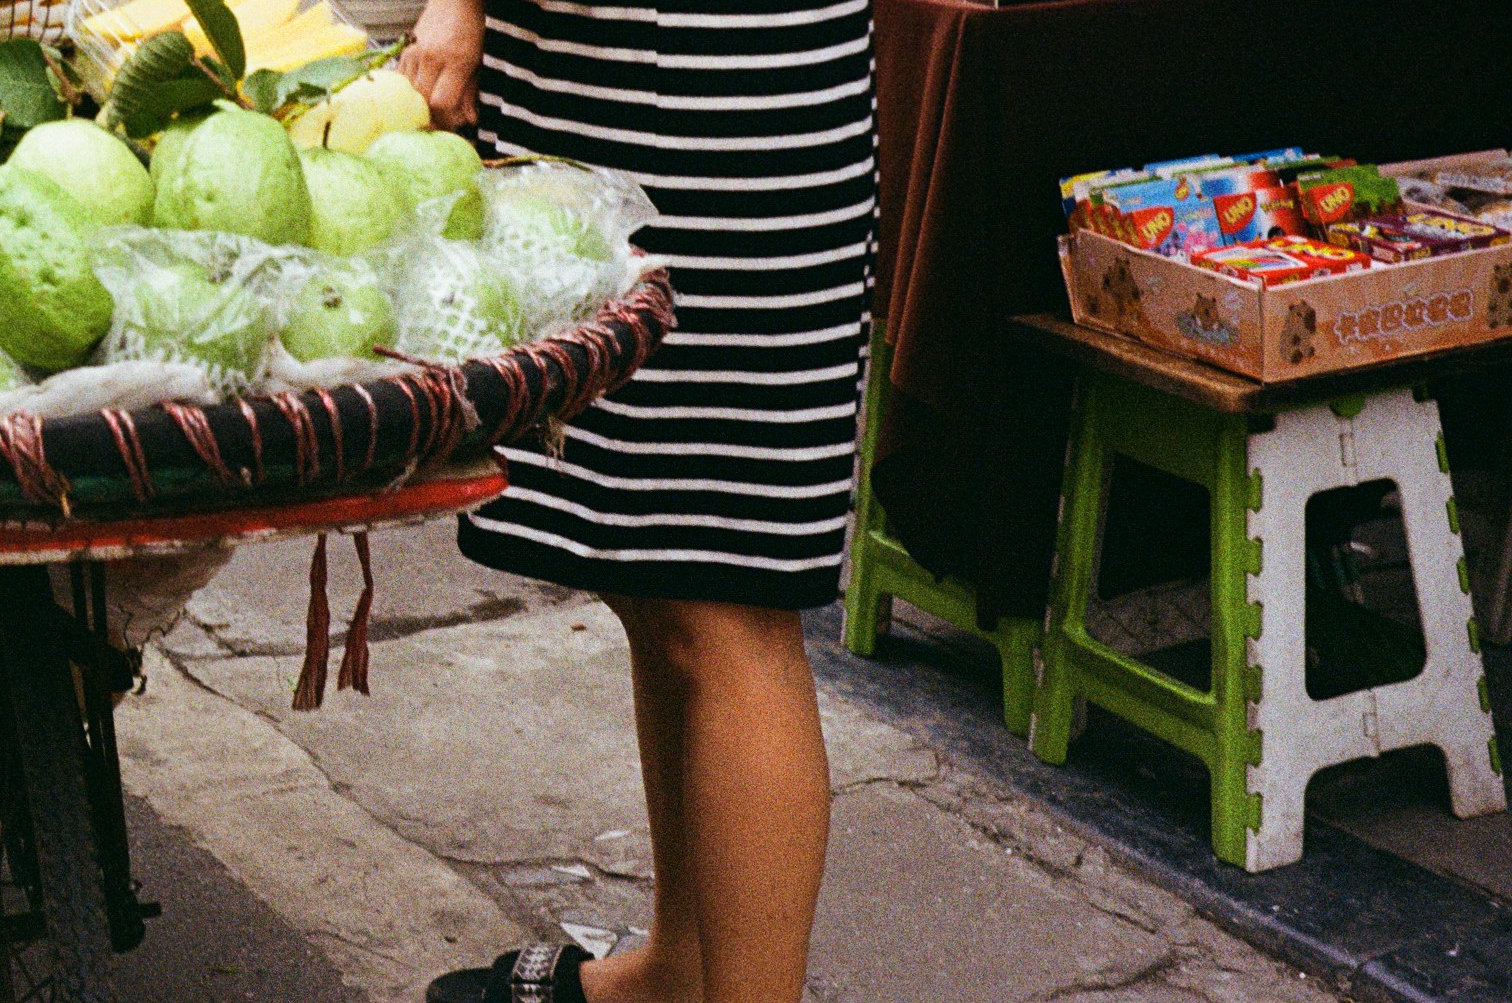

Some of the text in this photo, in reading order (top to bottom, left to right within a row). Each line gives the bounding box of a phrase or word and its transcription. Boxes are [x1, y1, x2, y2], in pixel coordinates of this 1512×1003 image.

[1223, 196, 1254, 224] UNO
[1320, 186, 1351, 214] UNO
[1141, 211, 1172, 240] UNO
